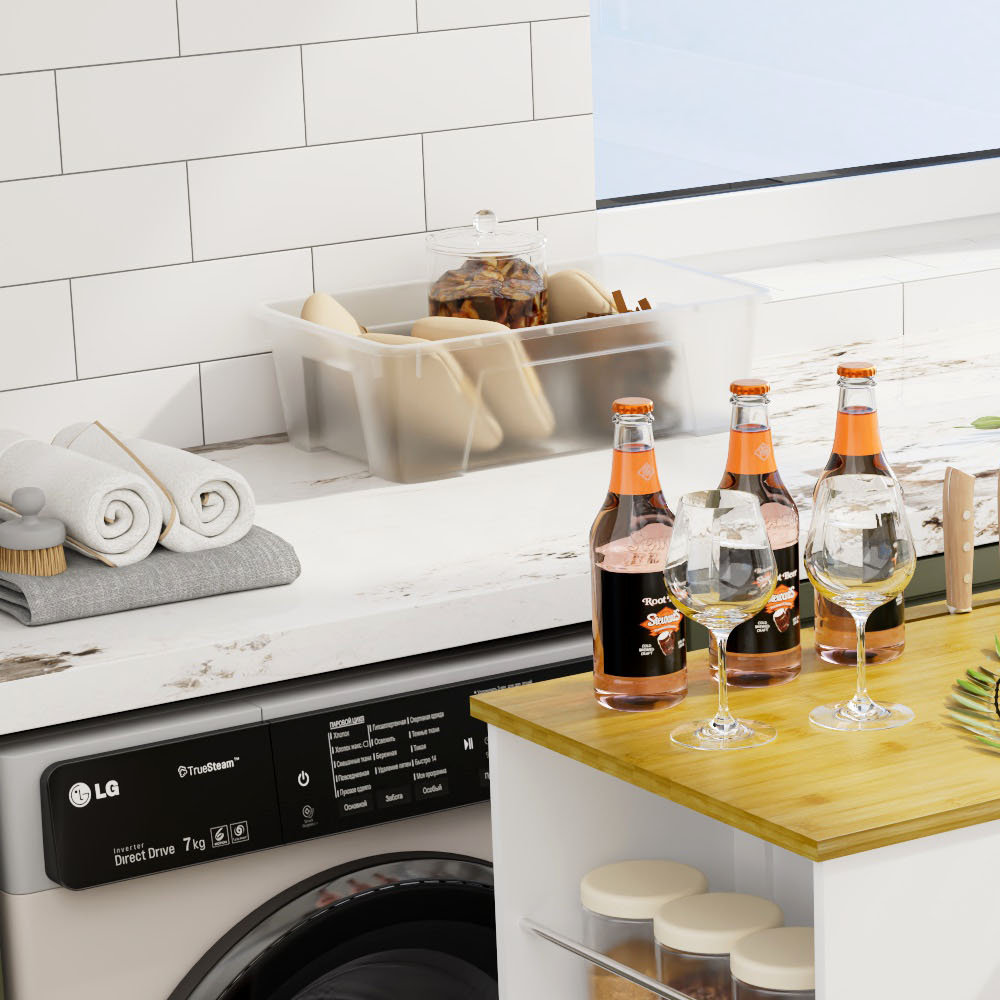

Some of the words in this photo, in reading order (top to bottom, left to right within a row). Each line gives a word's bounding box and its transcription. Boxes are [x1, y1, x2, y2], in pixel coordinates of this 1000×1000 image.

[642, 596, 667, 606] Root
[94, 780, 120, 800] LG
[422, 784, 443, 794] Особый
[385, 793, 404, 802] Забота
[344, 800, 368, 811] Основной
[113, 843, 145, 854] Inverter
[114, 851, 147, 867] Direct
[148, 845, 176, 859] Drive
